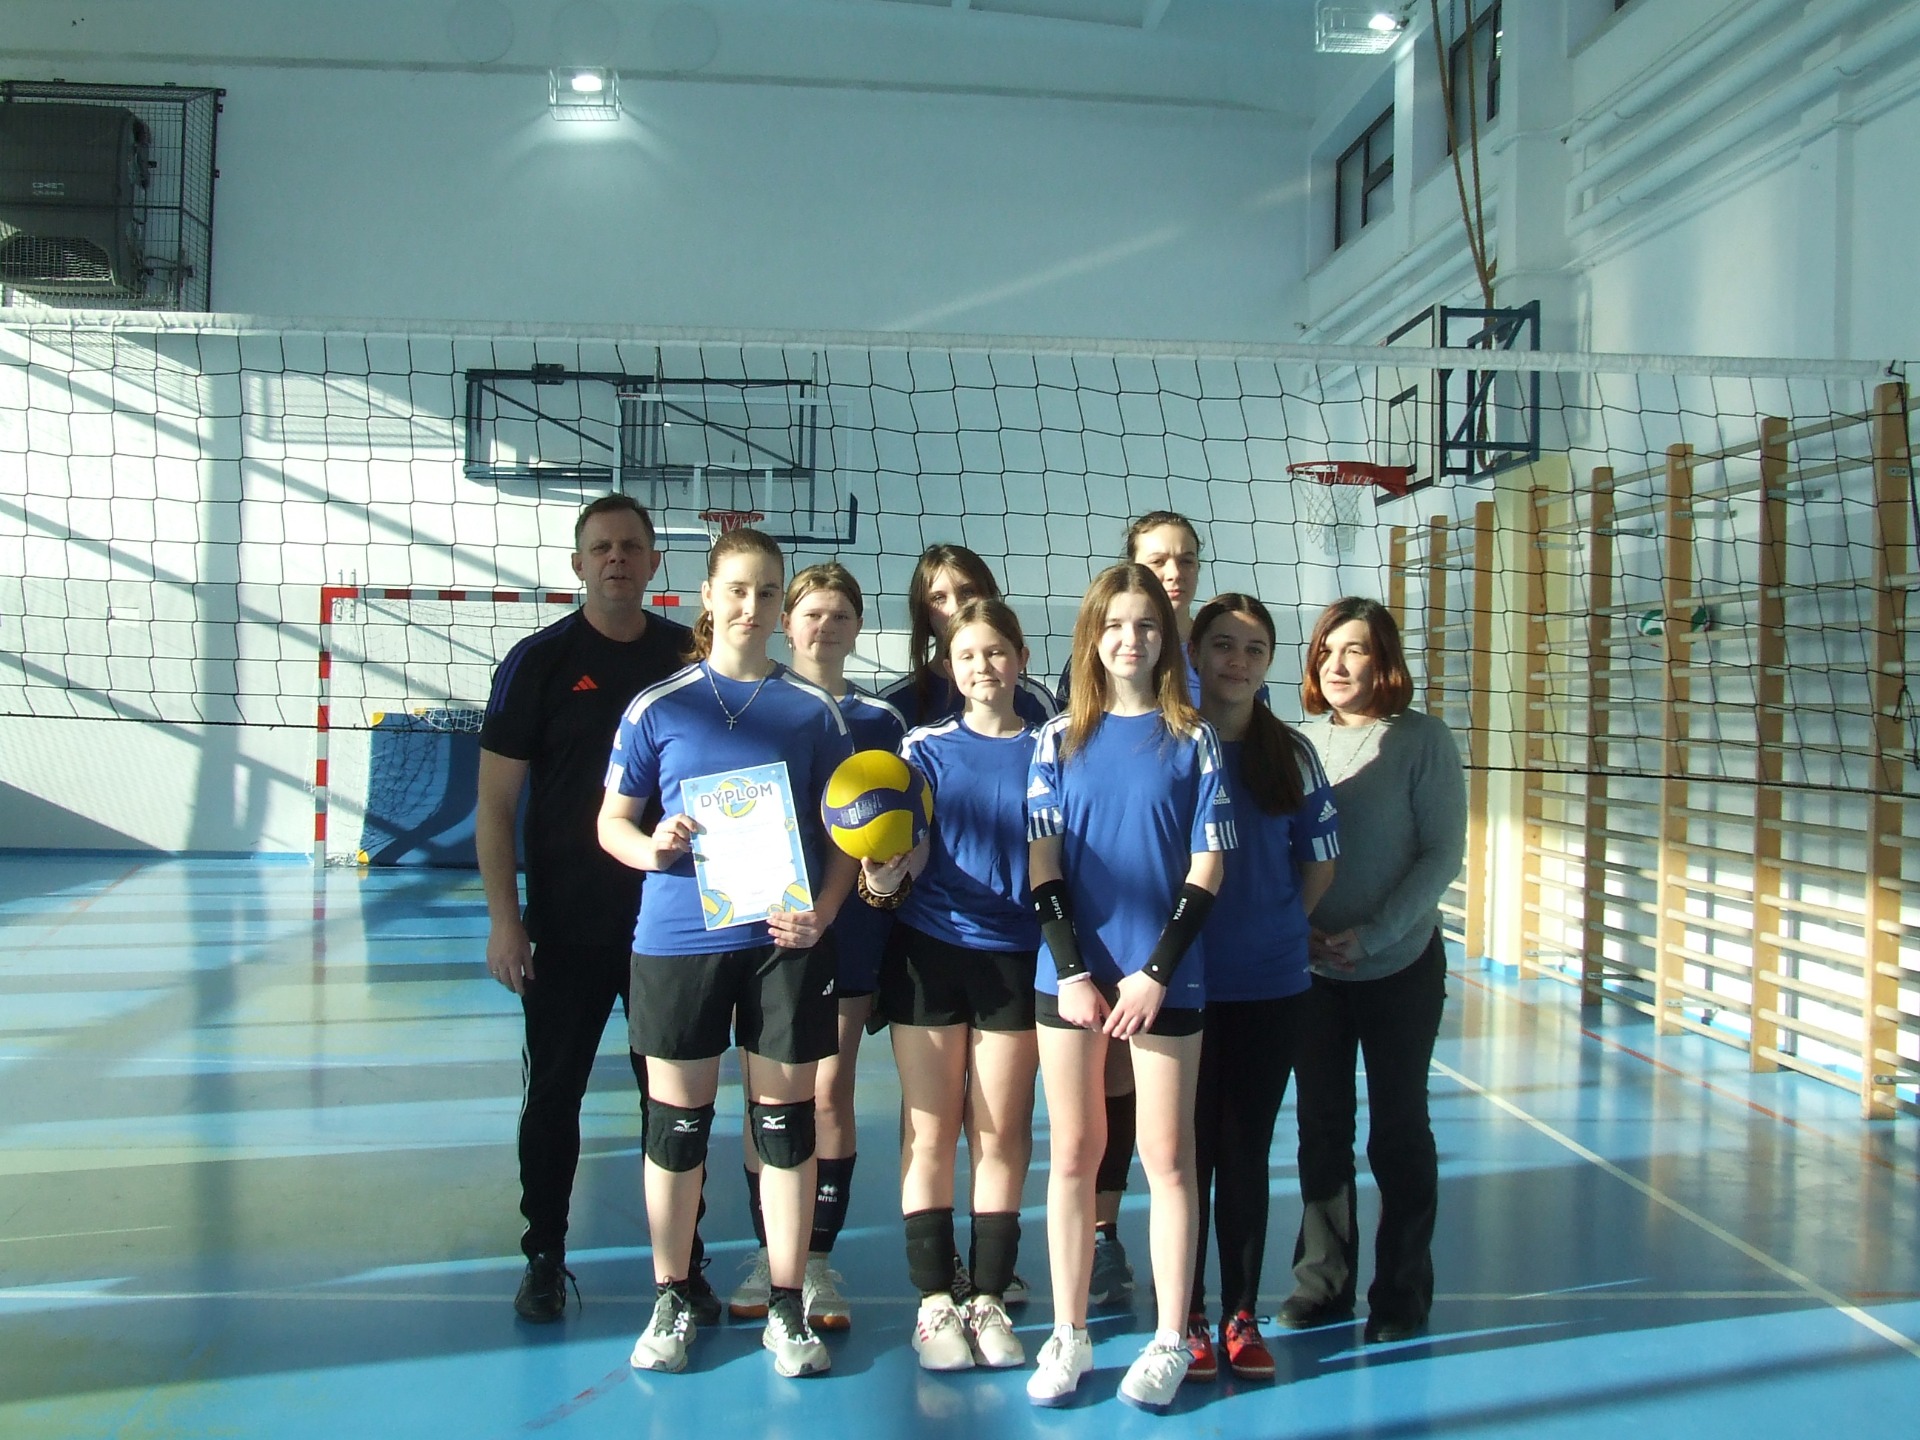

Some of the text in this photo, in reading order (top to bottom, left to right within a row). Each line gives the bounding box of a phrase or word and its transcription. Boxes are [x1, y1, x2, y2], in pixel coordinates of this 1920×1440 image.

[701, 783, 773, 808] DYPLOM
[1050, 895, 1064, 920] KIPSTA
[1172, 897, 1188, 921] KIPSTA
